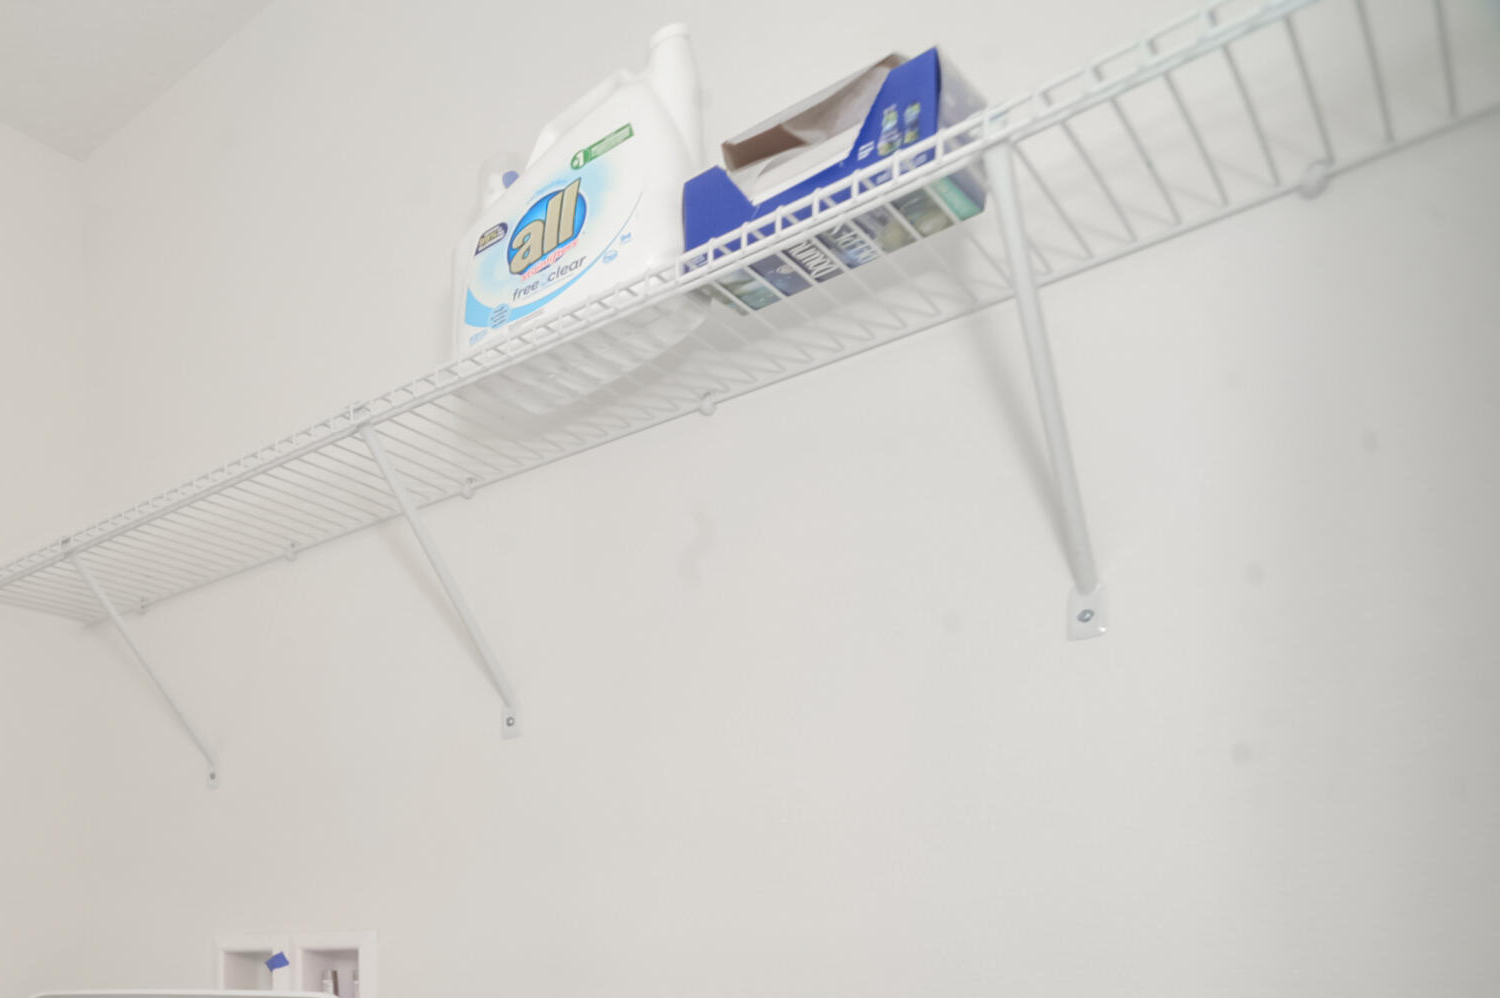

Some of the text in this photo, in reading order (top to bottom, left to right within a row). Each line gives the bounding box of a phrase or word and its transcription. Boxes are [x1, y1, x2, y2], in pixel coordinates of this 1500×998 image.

[509, 177, 582, 275] all
[512, 280, 540, 302] free
[547, 255, 587, 282] clear
